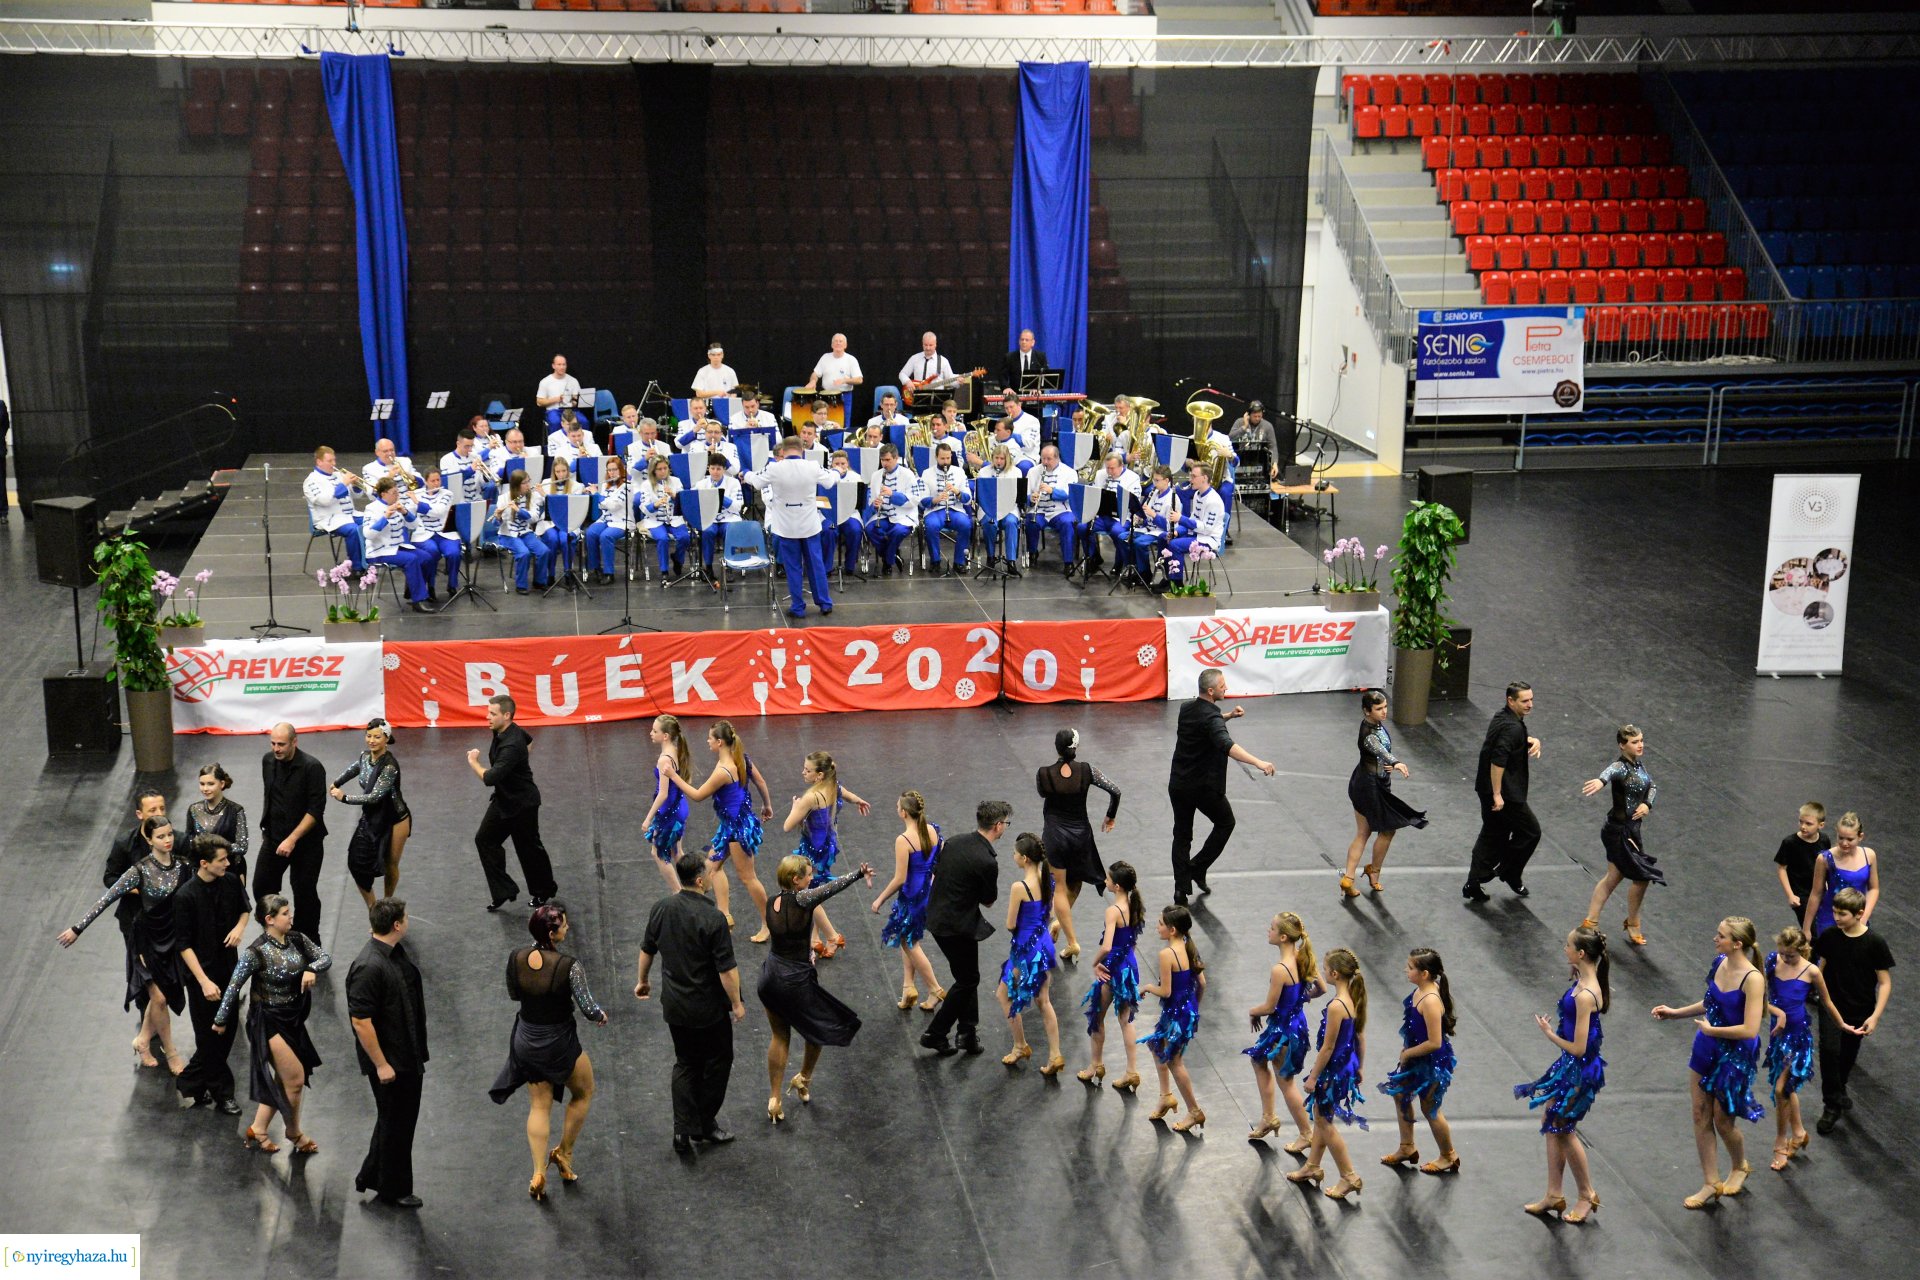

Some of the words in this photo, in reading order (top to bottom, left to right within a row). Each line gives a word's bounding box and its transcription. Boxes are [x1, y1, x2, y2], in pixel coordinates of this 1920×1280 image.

[1444, 312, 1468, 321] SENIO
[1469, 311, 1484, 320] KFT.
[1525, 325, 1563, 352] Pietra
[1423, 333, 1487, 356] SENIO
[1464, 356, 1487, 365] szalon
[1512, 354, 1575, 366] CSEMPEBOLT
[1433, 370, 1475, 378] www.senio.hu
[1521, 367, 1564, 375] www.pietra.hu
[1266, 646, 1347, 656] www.reveszgroup.com
[464, 635, 719, 717] BÚÉK
[844, 627, 1058, 691] 2020
[245, 682, 337, 692] www.reveszgroup.com
